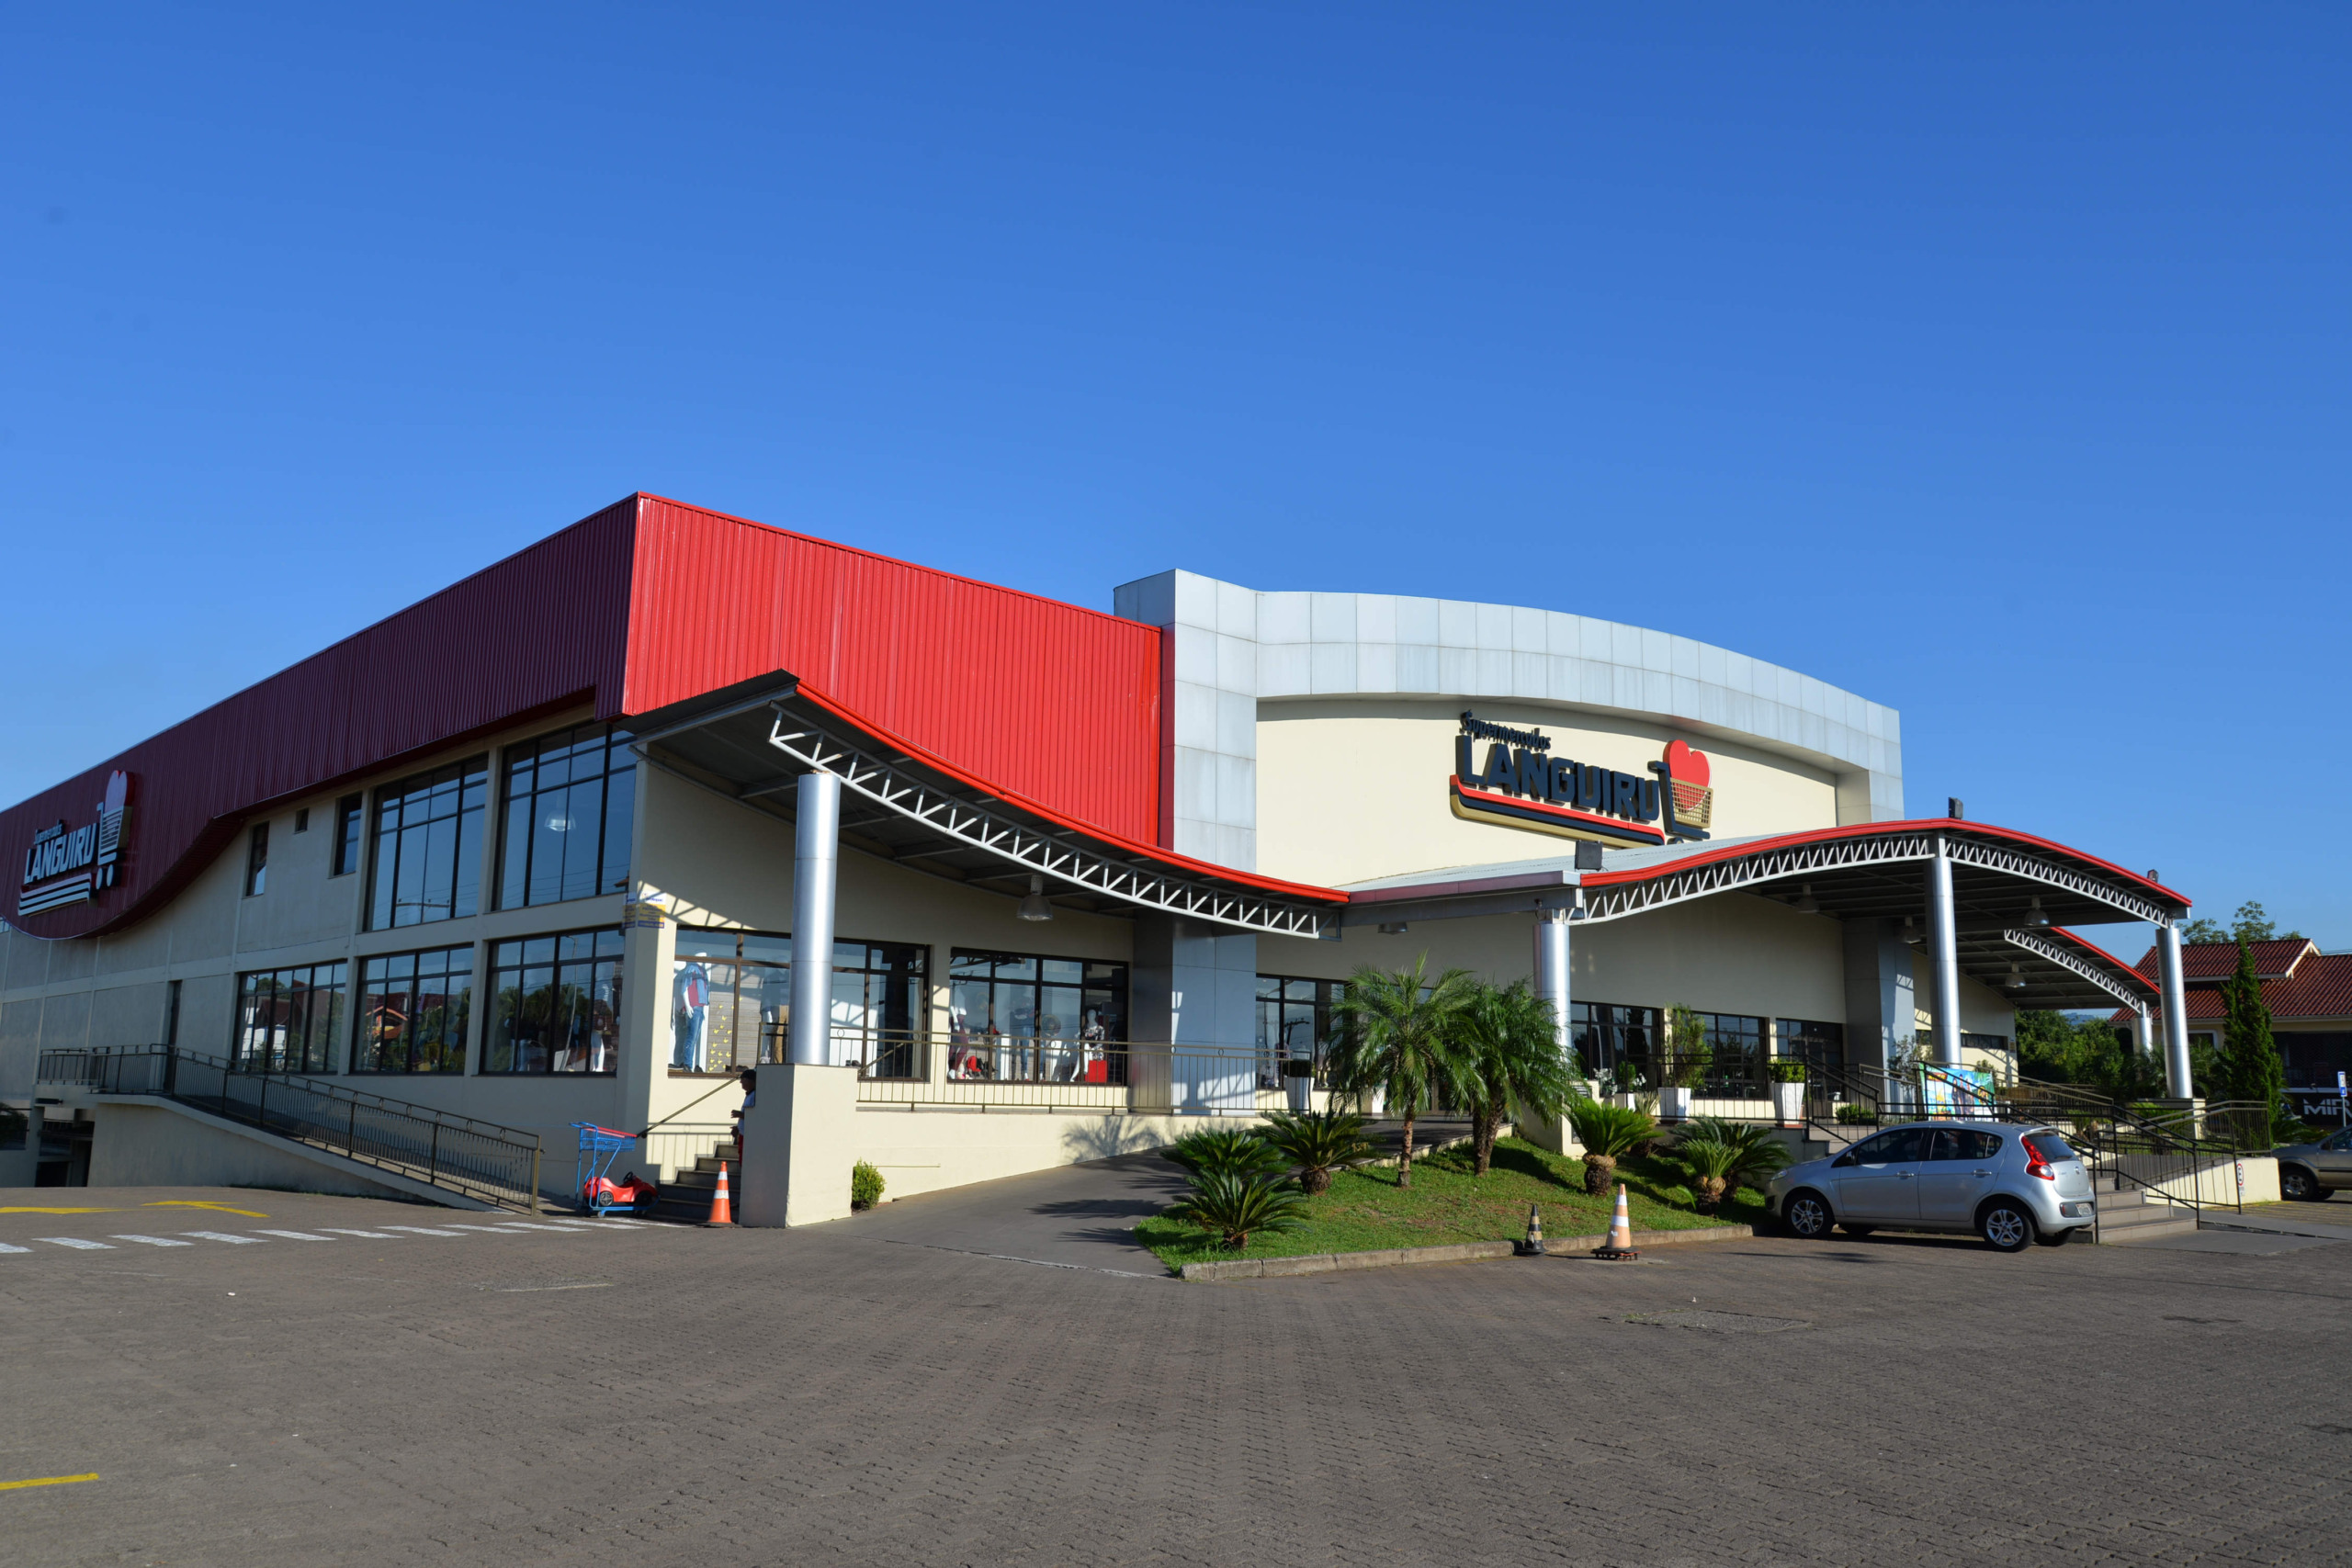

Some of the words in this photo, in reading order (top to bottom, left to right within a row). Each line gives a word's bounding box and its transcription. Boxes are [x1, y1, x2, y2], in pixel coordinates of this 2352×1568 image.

[1460, 710, 1551, 750] Supermercados
[1455, 735, 1660, 821] LANGUIRU
[24, 823, 97, 885] LANGUIRU
